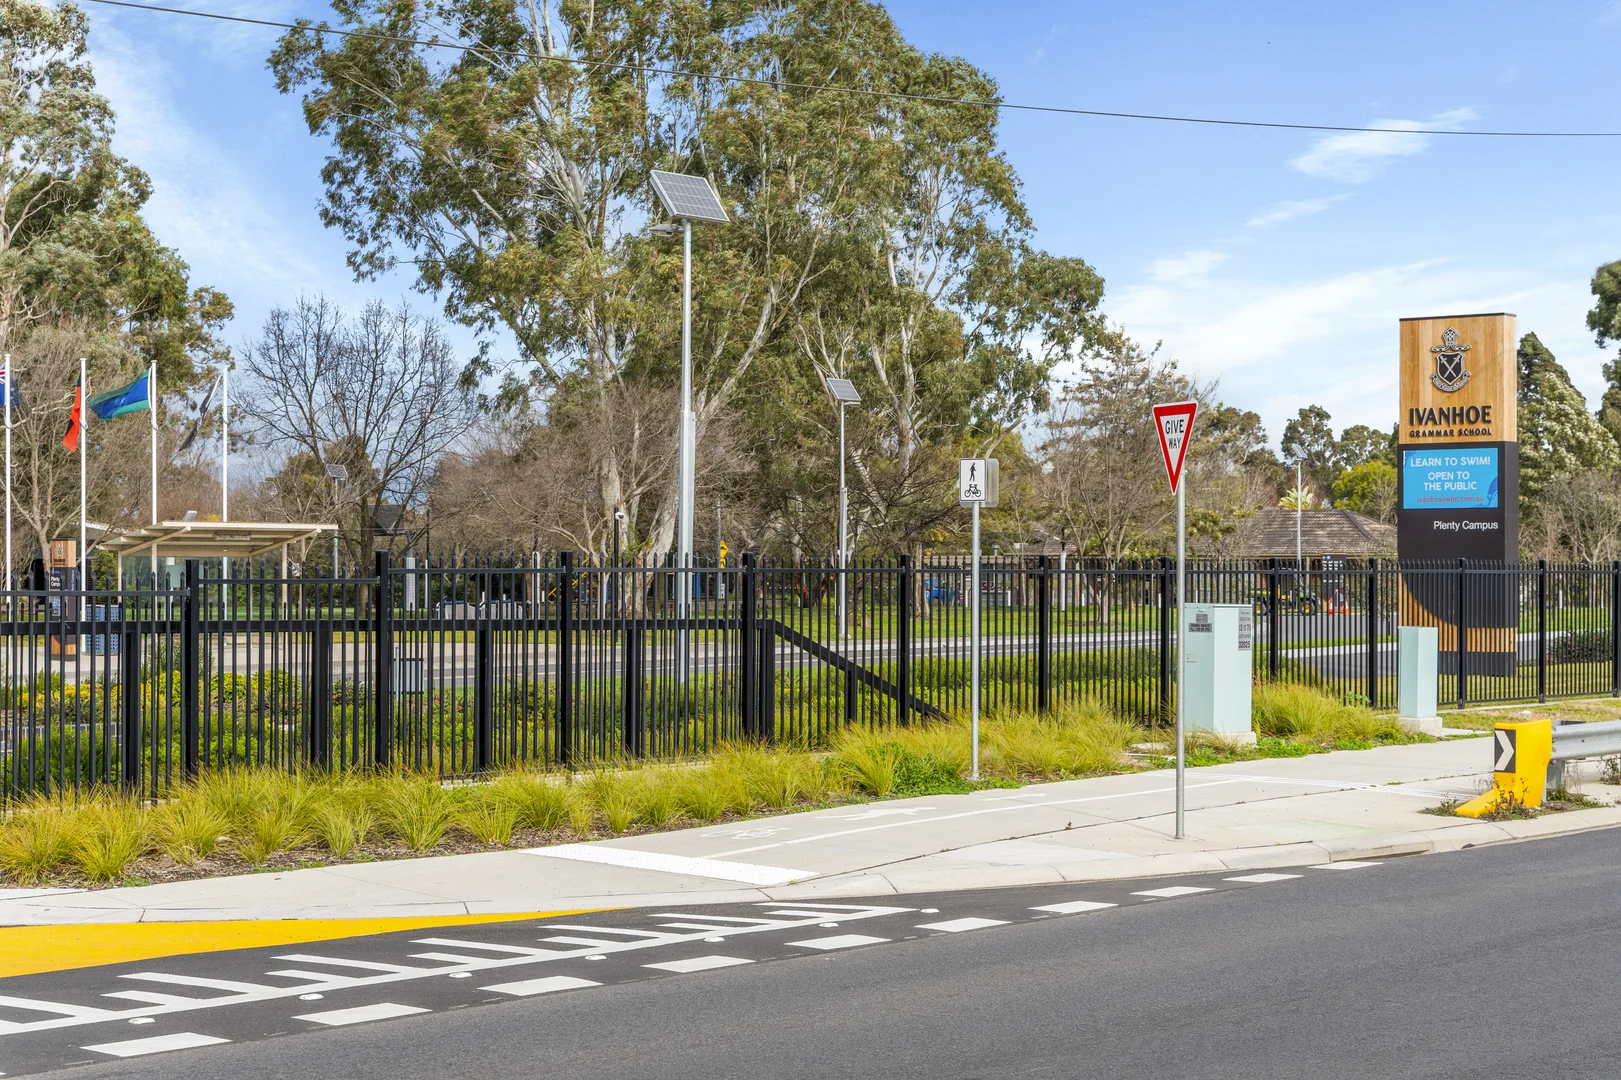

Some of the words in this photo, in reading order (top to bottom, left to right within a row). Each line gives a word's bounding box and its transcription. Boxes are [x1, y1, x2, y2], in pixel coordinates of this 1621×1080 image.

[1409, 405, 1492, 426] IVANHOE
[1165, 419, 1184, 434] GIVE
[1409, 429, 1455, 438] GRAMMAR
[1458, 428, 1492, 436] SCHOOL
[1168, 437, 1181, 449] WAY
[1410, 458, 1442, 467] LEARN
[1444, 457, 1458, 466] TO
[1460, 456, 1491, 466] SWIM!
[1427, 471, 1454, 480] OPEN
[1456, 471, 1470, 480] TO
[1423, 482, 1442, 491] THE
[1444, 481, 1477, 490] PUBLIC
[1433, 520, 1460, 531] Plenty
[1462, 520, 1498, 531] Campus
